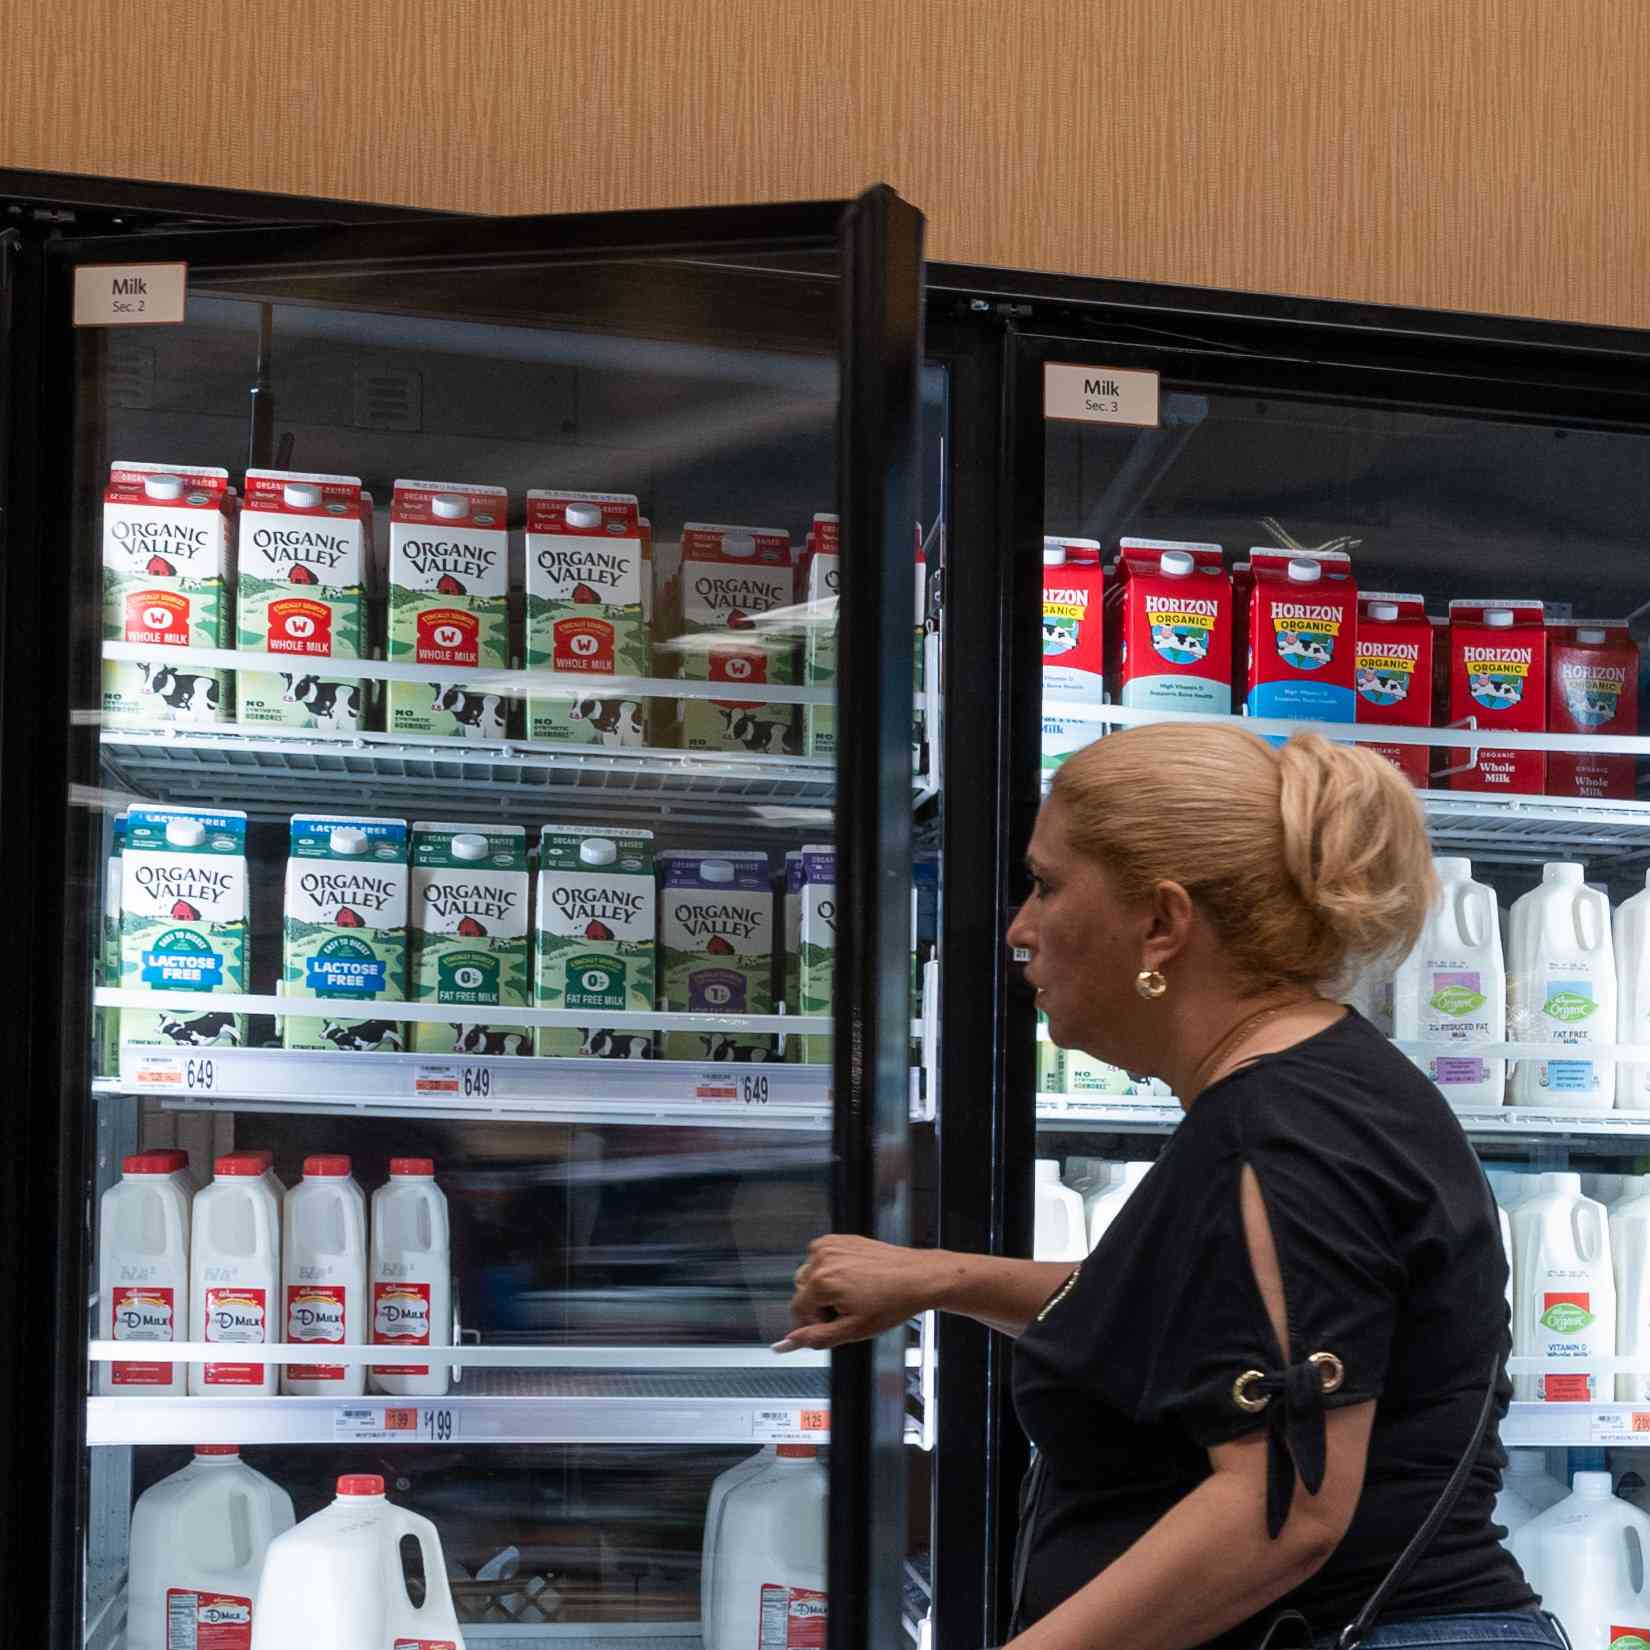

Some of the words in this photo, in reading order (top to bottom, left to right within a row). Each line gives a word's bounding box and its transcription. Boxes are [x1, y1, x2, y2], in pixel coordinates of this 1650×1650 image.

[112, 279, 147, 295] Milk
[112, 301, 136, 313] Sec.
[138, 301, 145, 312] 2
[1084, 379, 1120, 397] Milk
[1085, 399, 1108, 412] Sec.
[1110, 402, 1118, 412] 3
[111, 521, 208, 546] ORGANIC
[253, 529, 349, 555] ORGANIC
[120, 538, 199, 560] VALLEY
[262, 546, 341, 568] VALLEY
[402, 541, 497, 566] ORGANIC
[411, 557, 488, 579] VALLEY
[537, 550, 631, 574] ORGANIC
[545, 566, 623, 588] VALLEY
[695, 577, 783, 601] ORGANIC
[704, 593, 775, 611] VALLEY
[1146, 595, 1218, 616] HORIZON
[1156, 614, 1208, 627] ORGANIC
[1271, 602, 1343, 622] HORIZON
[1280, 619, 1332, 633] ORGANIC
[127, 632, 161, 644] WHOLE
[164, 633, 188, 645] MILK
[270, 638, 304, 652] WHOLE
[306, 641, 330, 653] MILK
[419, 649, 451, 661] WHOLE
[454, 651, 477, 662] MILK
[1356, 641, 1418, 660] HORIZON
[1463, 646, 1531, 664] HORIZON
[556, 658, 588, 670] WHOLE
[591, 660, 612, 671] MILK
[1360, 659, 1408, 670] ORGANIC
[1473, 663, 1522, 674] ORGANIC
[1480, 762, 1516, 774] Whole
[1485, 773, 1511, 784] Milk
[1575, 776, 1609, 788] Whole
[136, 866, 233, 891] ORGANIC
[301, 873, 397, 897] ORGANIC
[145, 884, 224, 904] VALLEY
[308, 891, 388, 911] VALLEY
[423, 884, 517, 906] ORGANIC
[552, 887, 645, 910] ORGANIC
[432, 900, 509, 920] VALLEY
[560, 904, 636, 924] VALLEY
[675, 904, 763, 926] ORGANIC
[682, 923, 756, 939] VALLEY
[149, 955, 215, 969] LACTOSE
[314, 962, 378, 975] LACTOSE
[163, 969, 201, 981] FREE
[327, 976, 364, 986] FREE
[439, 991, 453, 1001] FAT
[456, 992, 476, 1002] FREE
[478, 993, 497, 1002] MILK
[566, 994, 580, 1003] FAT
[583, 995, 603, 1004] FREE
[605, 996, 624, 1006] MILK
[1553, 1031, 1567, 1039] FAT
[1569, 1031, 1588, 1039] FREE
[1548, 1344, 1578, 1352] VITAMIN
